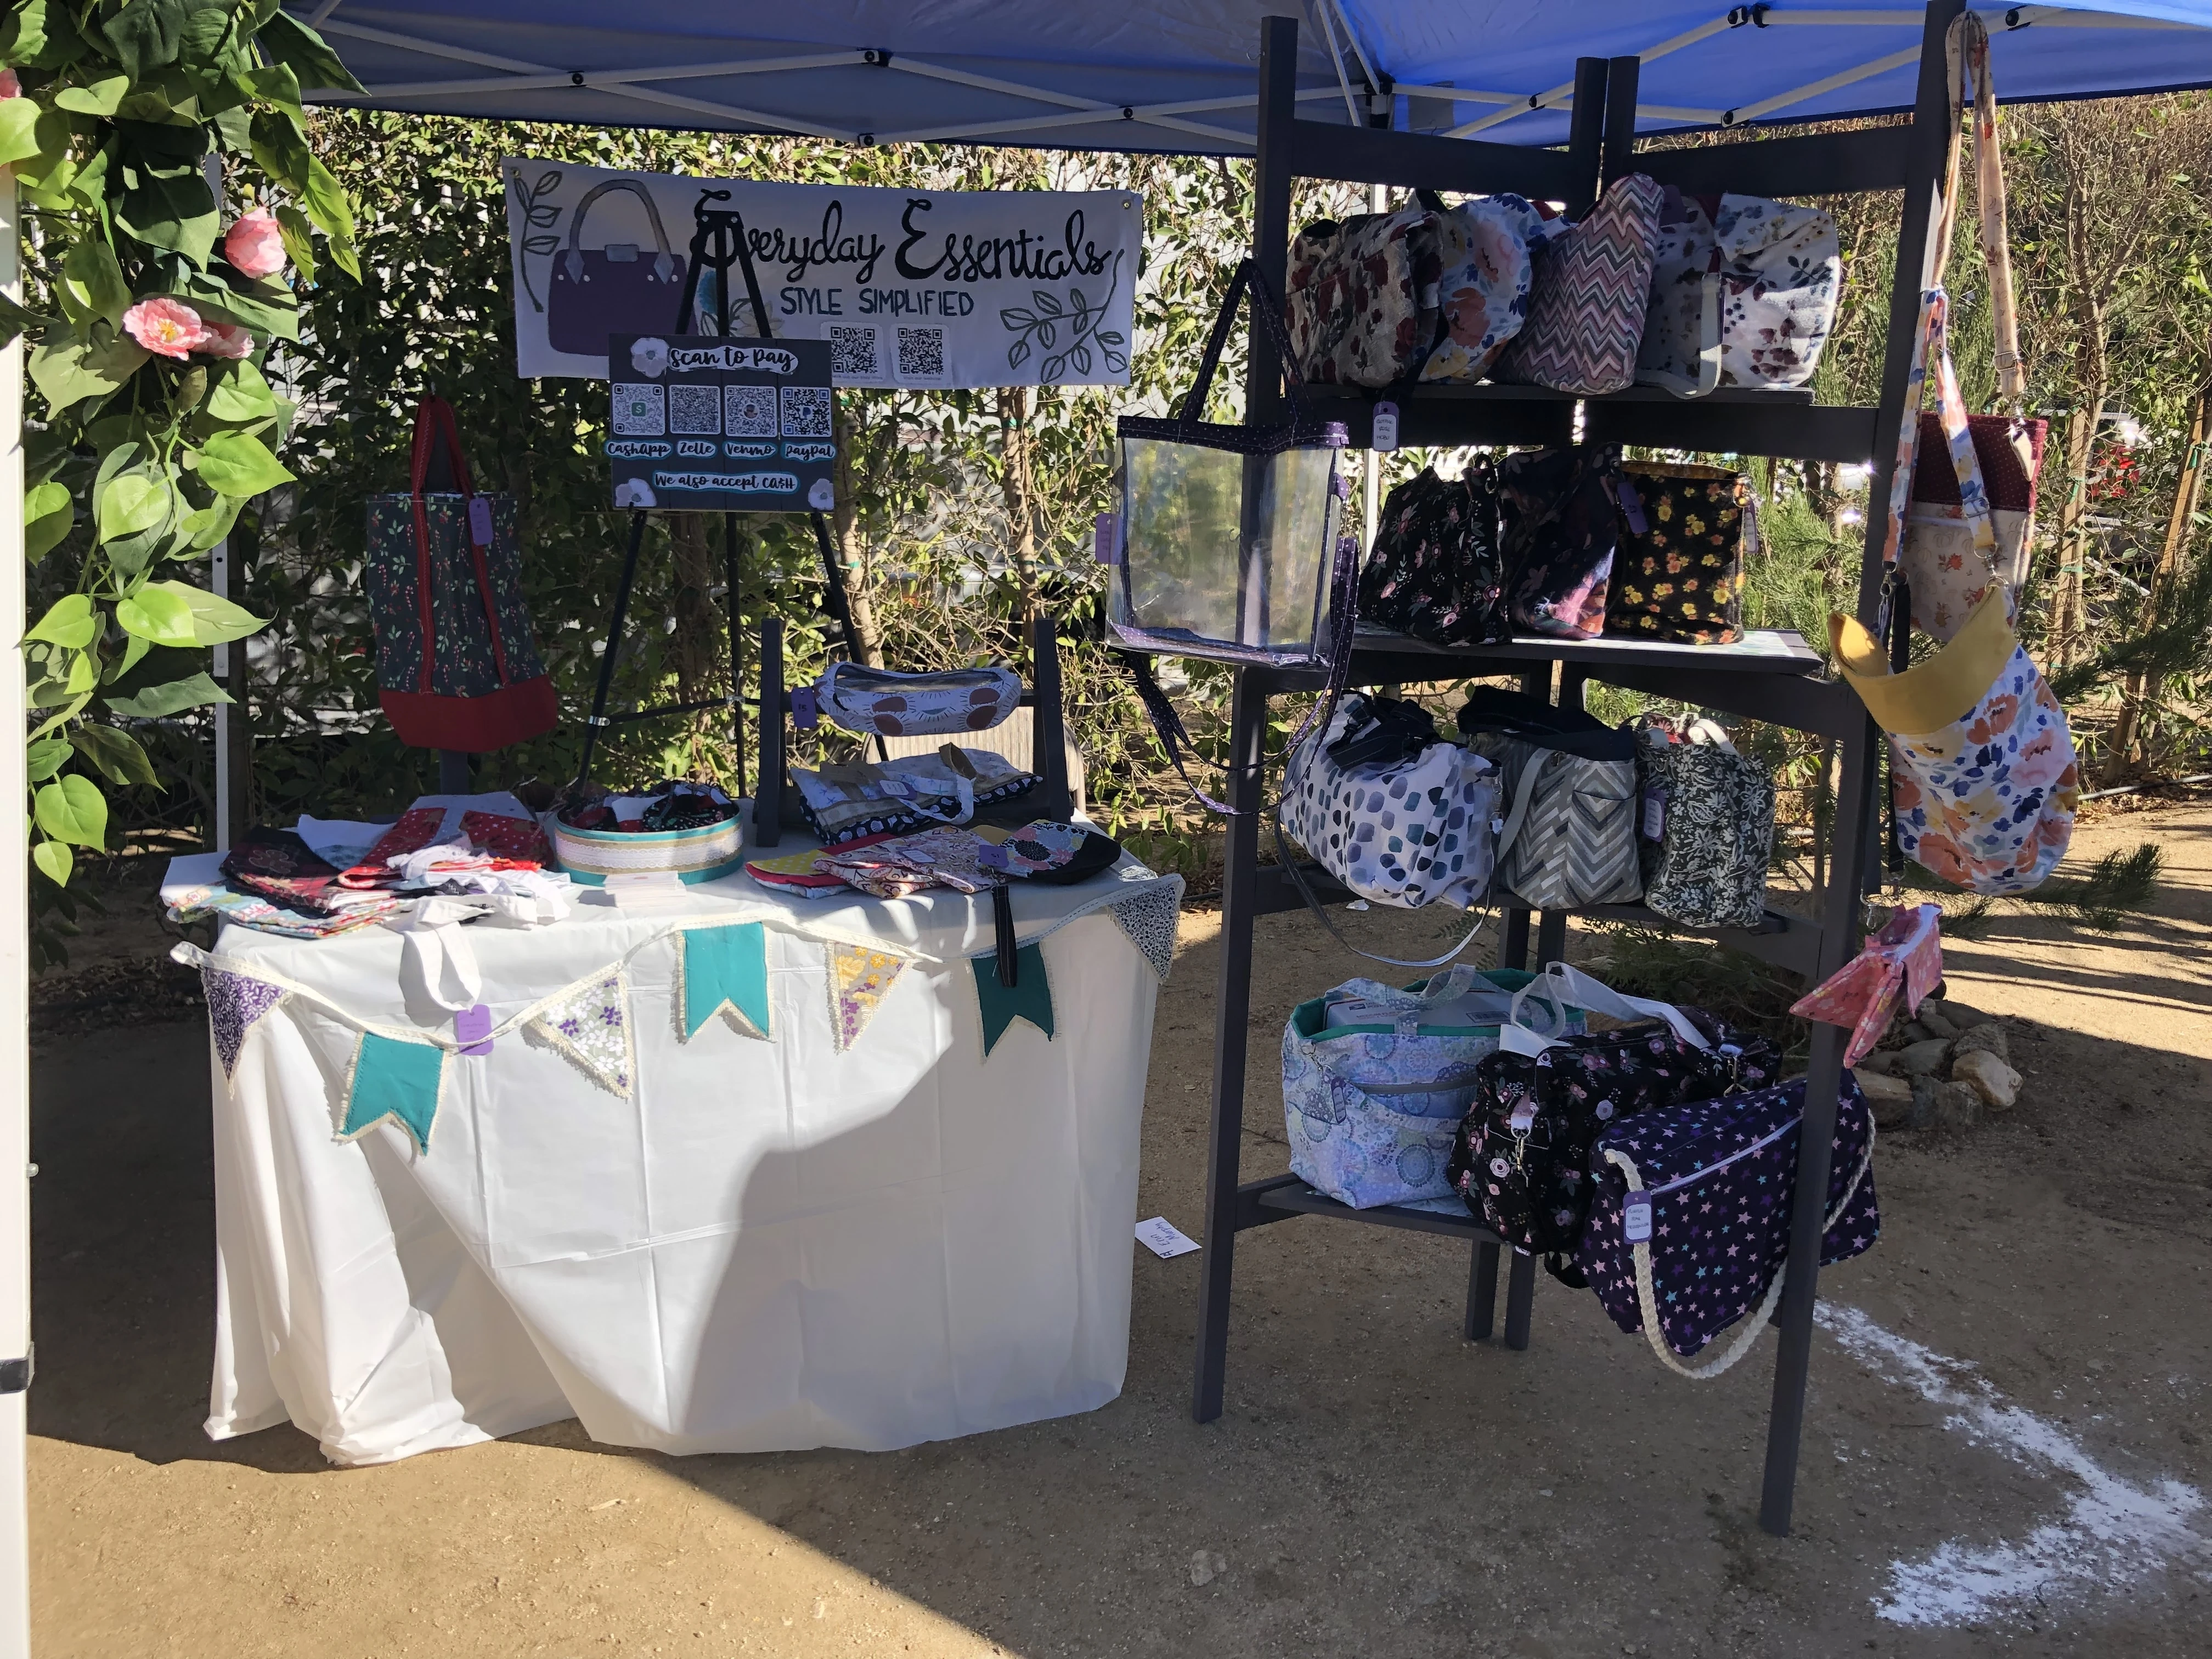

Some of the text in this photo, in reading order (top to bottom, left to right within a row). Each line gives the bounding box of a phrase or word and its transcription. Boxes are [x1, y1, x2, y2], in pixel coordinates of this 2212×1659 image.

[895, 199, 1111, 283] Essentials
[781, 287, 974, 317] STYLE SIMPLIFIED
[724, 347, 749, 366] to
[680, 442, 714, 454] Zelle
[727, 443, 775, 455] Venmo
[656, 473, 675, 486] We
[679, 475, 709, 488] also
[712, 475, 759, 490] accept
